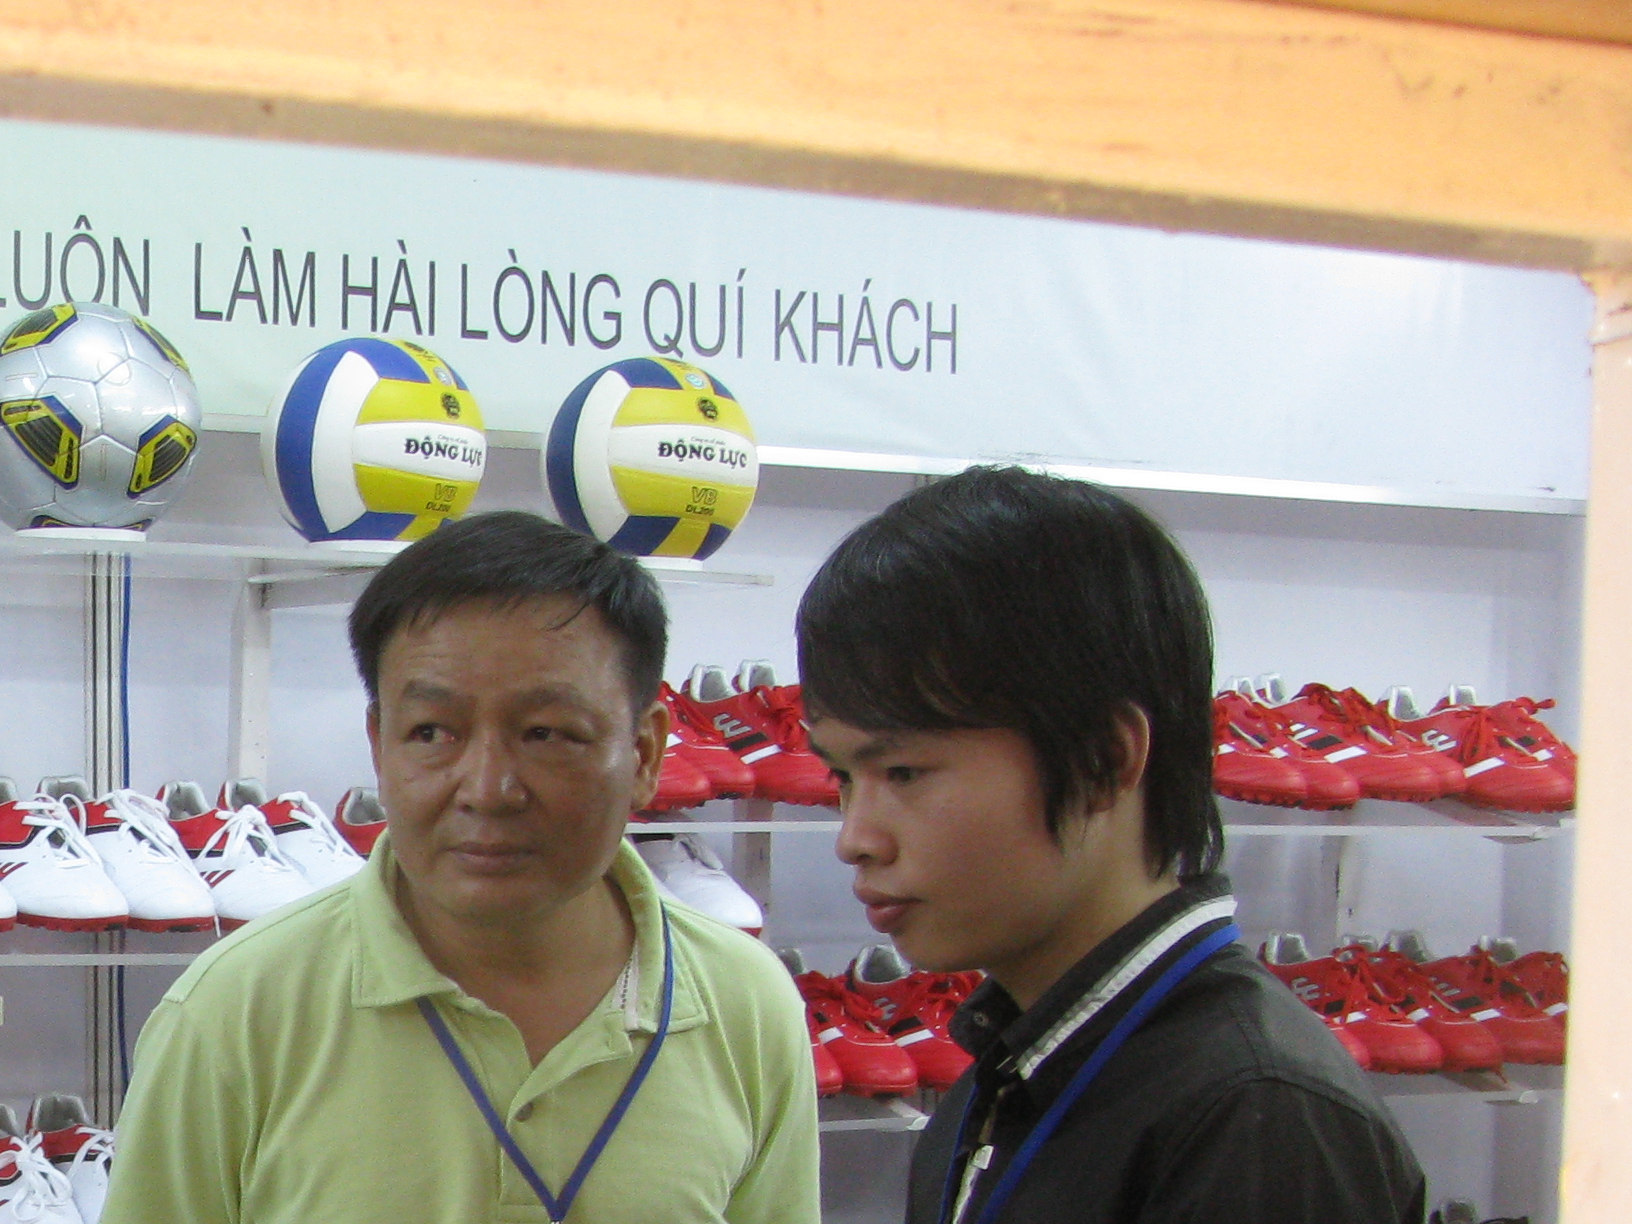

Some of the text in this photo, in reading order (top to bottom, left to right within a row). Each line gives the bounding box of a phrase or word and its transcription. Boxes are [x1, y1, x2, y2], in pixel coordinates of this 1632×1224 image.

[193, 226, 317, 328] LÀM
[340, 239, 436, 337] HÀI
[459, 248, 623, 351] LÒNG
[642, 267, 747, 359] QUÍ
[774, 278, 958, 374] KHÁCH
[658, 438, 715, 463] ĐỘNG
